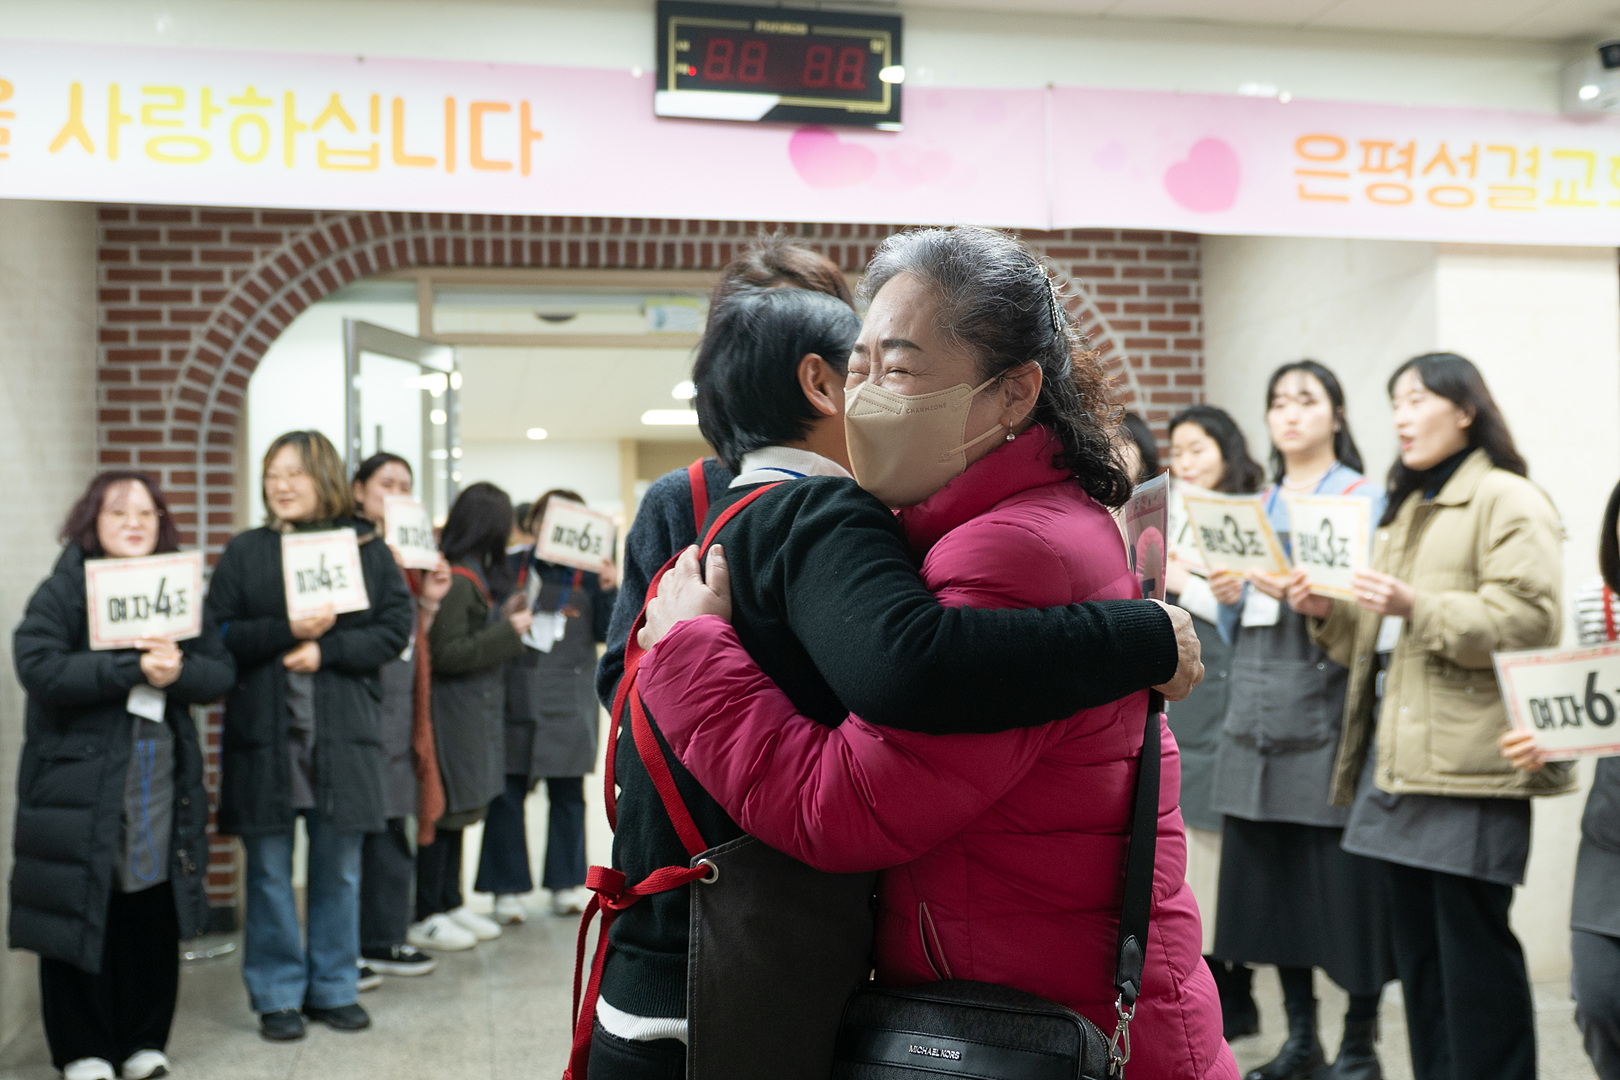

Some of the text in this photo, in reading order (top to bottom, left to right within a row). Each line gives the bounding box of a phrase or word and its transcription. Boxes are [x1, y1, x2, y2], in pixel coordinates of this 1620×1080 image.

[48, 82, 544, 177] 사랑하십니다
[109, 576, 188, 623] 여자4조
[908, 1044, 962, 1060] MICHAEL KORS
